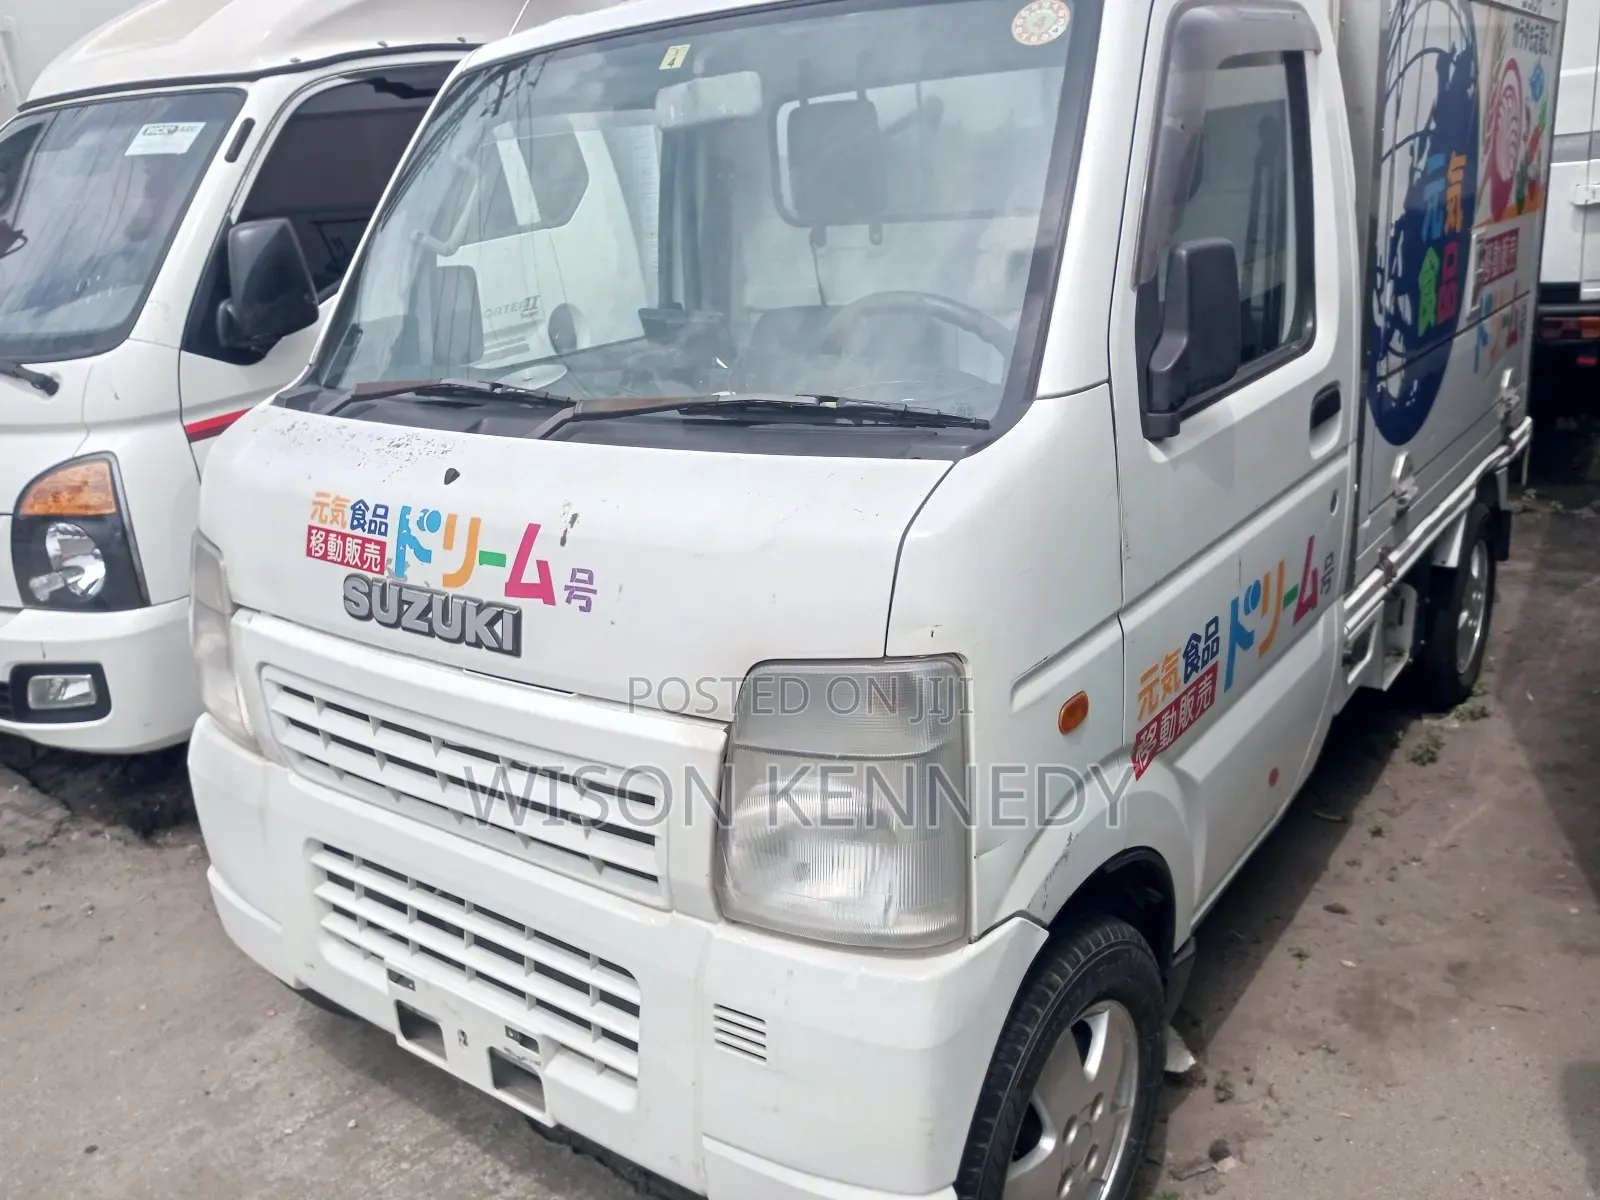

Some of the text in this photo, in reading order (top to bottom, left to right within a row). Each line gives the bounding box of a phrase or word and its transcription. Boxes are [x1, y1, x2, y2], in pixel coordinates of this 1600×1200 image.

[1421, 151, 1468, 244] 元気
[1418, 241, 1459, 338] 食品
[307, 527, 385, 574] 移動販売
[310, 490, 390, 538] 元気食品
[342, 572, 522, 658] SUZUKI
[1137, 615, 1220, 721] 元気食品
[1134, 670, 1216, 772] 移動販売
